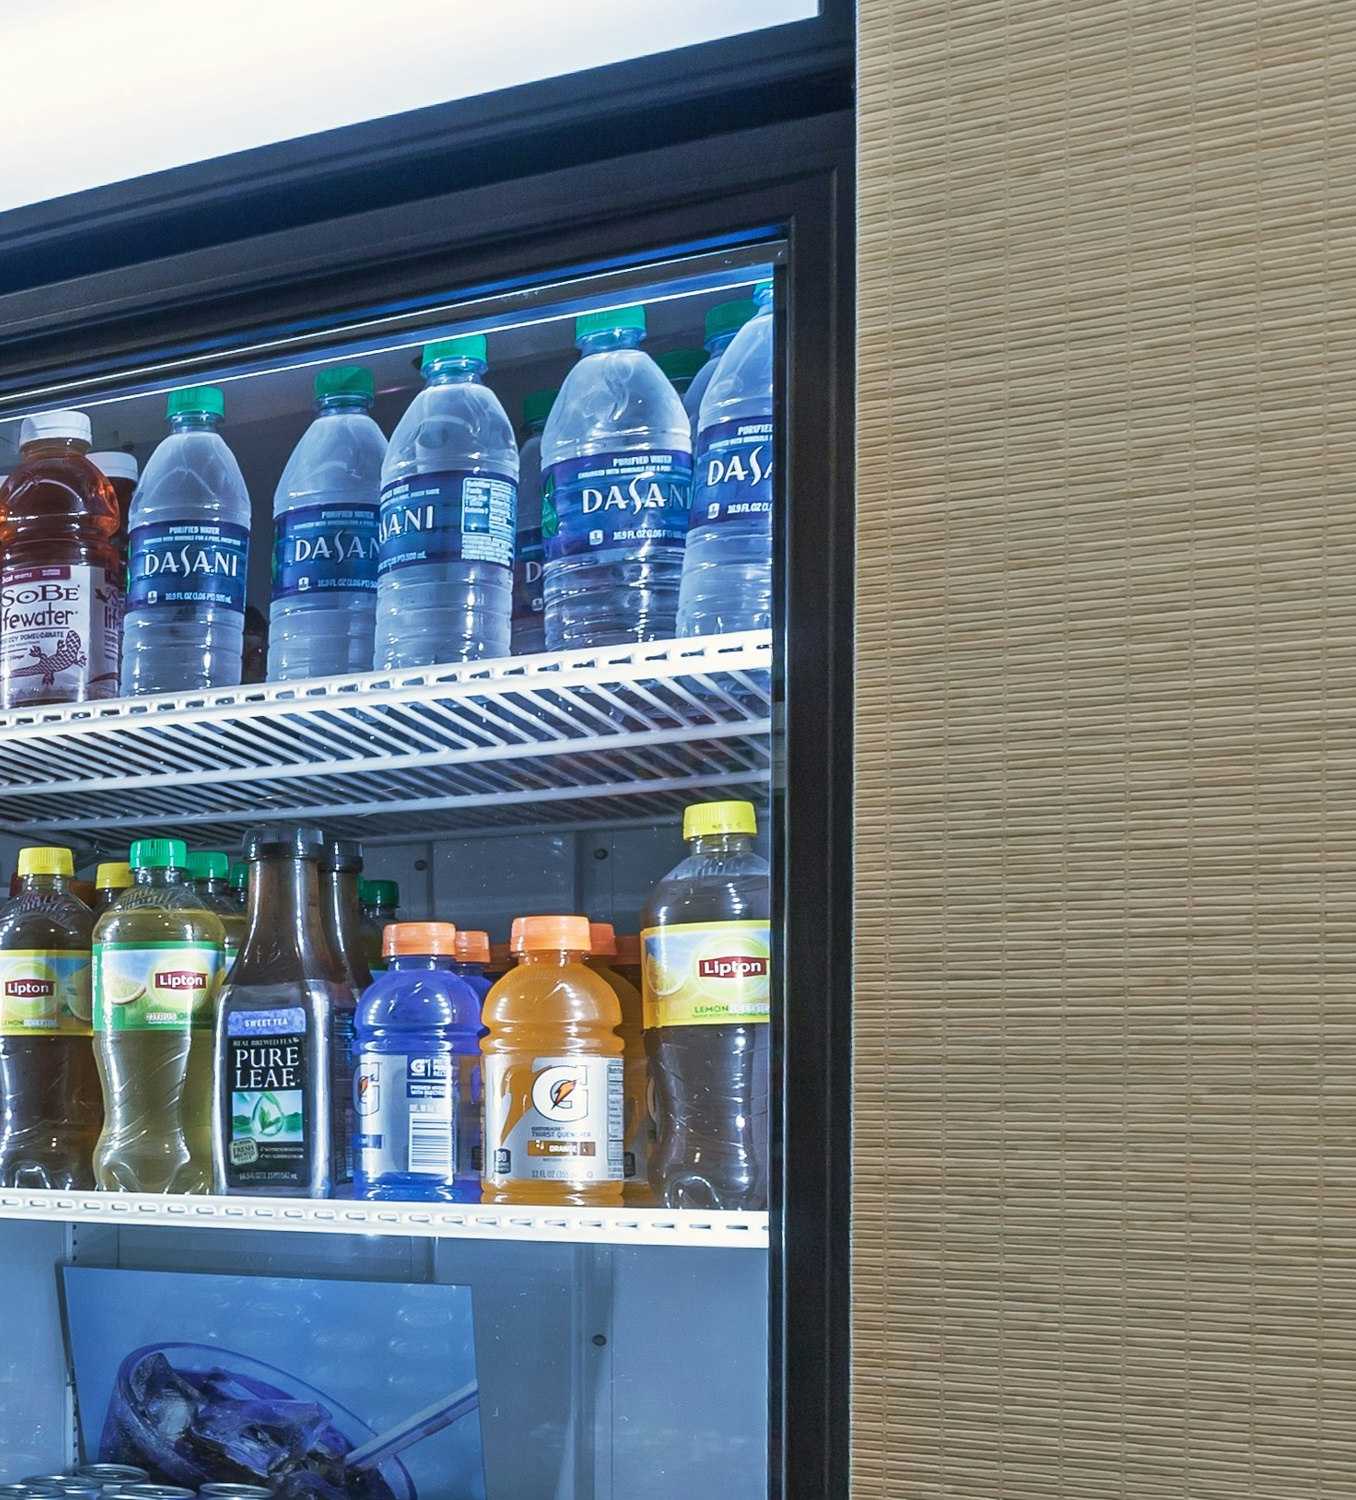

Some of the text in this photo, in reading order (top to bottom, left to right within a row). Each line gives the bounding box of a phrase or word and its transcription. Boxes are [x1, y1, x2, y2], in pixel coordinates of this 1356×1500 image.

[738, 424, 773, 435] PURIFIE
[707, 446, 773, 487] DAS
[582, 472, 690, 515] DASANI
[378, 505, 434, 544] SANI
[294, 529, 380, 564] DASAN
[145, 544, 237, 578] DASANI
[704, 961, 761, 976] Lipton
[8, 982, 49, 995] Lipton
[160, 974, 203, 988] Lipton
[695, 1005, 728, 1013] LEMON
[244, 1018, 288, 1027] SWEET TEA
[235, 1046, 300, 1068] PURE
[235, 1067, 295, 1089] LEAF
[531, 1064, 590, 1123] G
